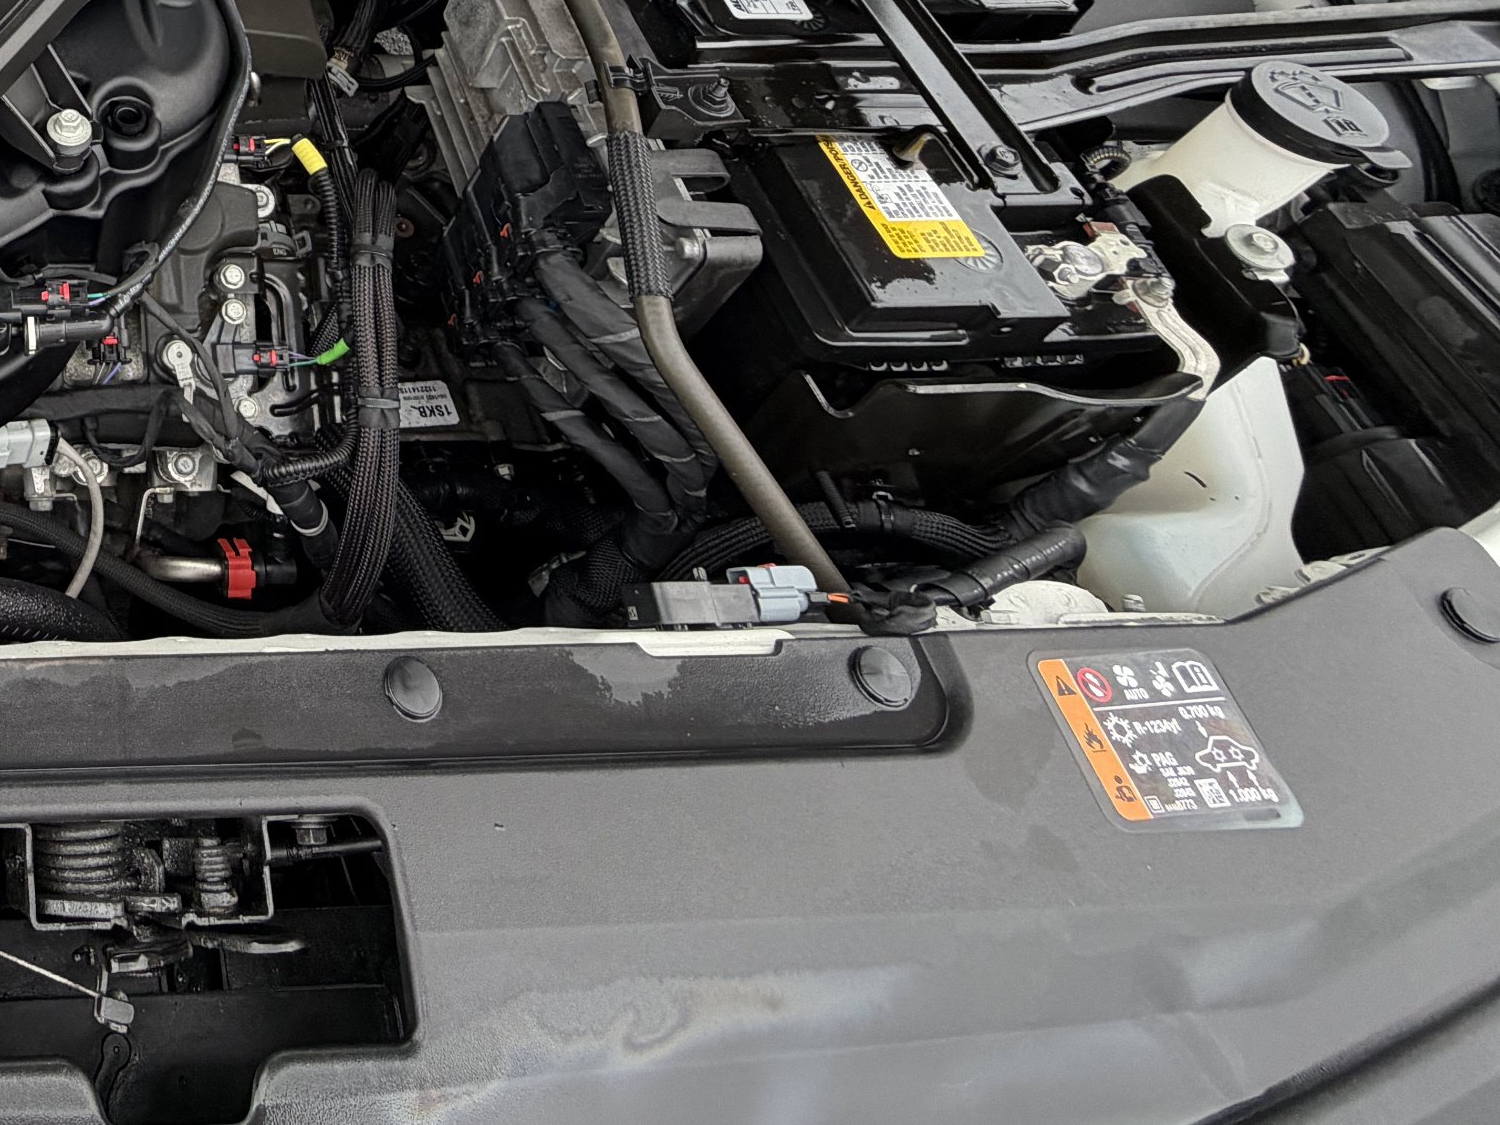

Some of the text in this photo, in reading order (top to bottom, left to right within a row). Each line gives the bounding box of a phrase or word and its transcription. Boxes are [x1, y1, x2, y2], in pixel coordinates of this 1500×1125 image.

[1124, 687, 1149, 701] AUTO
[1178, 704, 1226, 720] 0.700 kg
[1151, 751, 1179, 767] PAG
[1229, 786, 1279, 803] 1.000 kg
